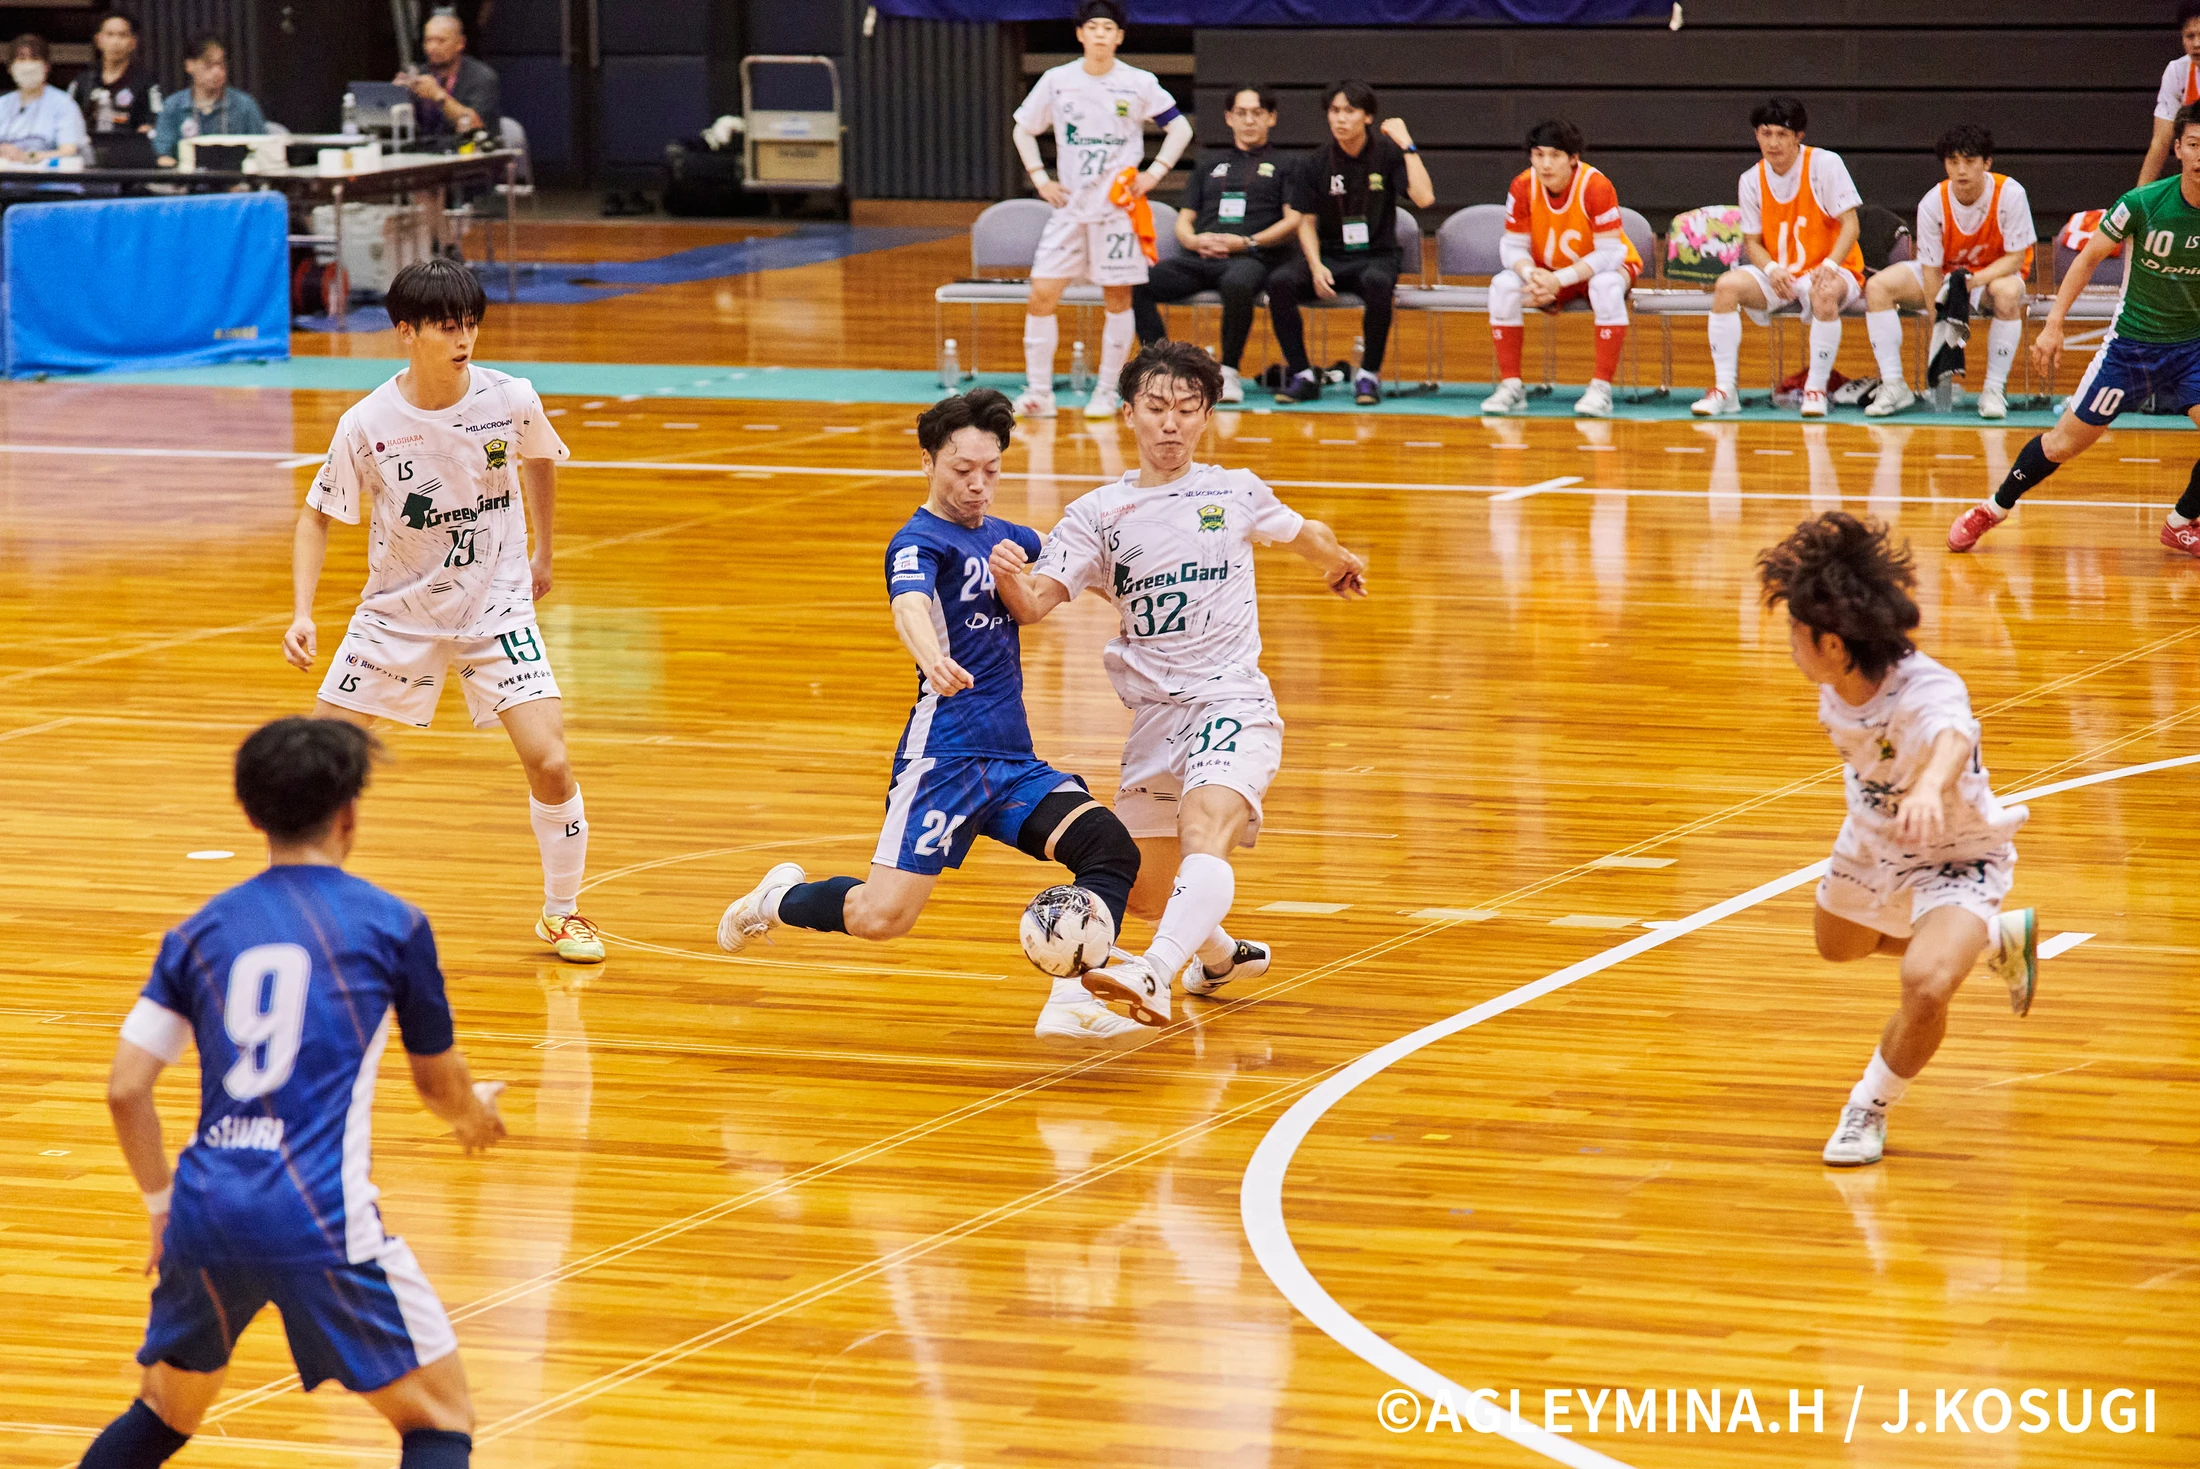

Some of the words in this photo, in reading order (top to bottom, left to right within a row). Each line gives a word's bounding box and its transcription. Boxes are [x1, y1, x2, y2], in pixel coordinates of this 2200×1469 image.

[1079, 149, 1108, 175] 27
[1106, 232, 1135, 260] 27
[2144, 229, 2175, 258] 10
[2089, 386, 2125, 417] 10
[465, 418, 513, 434] MILKCROWN
[398, 460, 414, 482] LS
[444, 528, 475, 568] 19
[959, 556, 997, 602] 24
[1180, 560, 1228, 583] Gard
[1131, 591, 1188, 637] 32
[494, 626, 542, 666] 19
[338, 673, 362, 693] LS
[1188, 717, 1243, 759] 32
[565, 820, 580, 838] LS
[914, 809, 967, 857] 24
[222, 943, 313, 1103] 9
